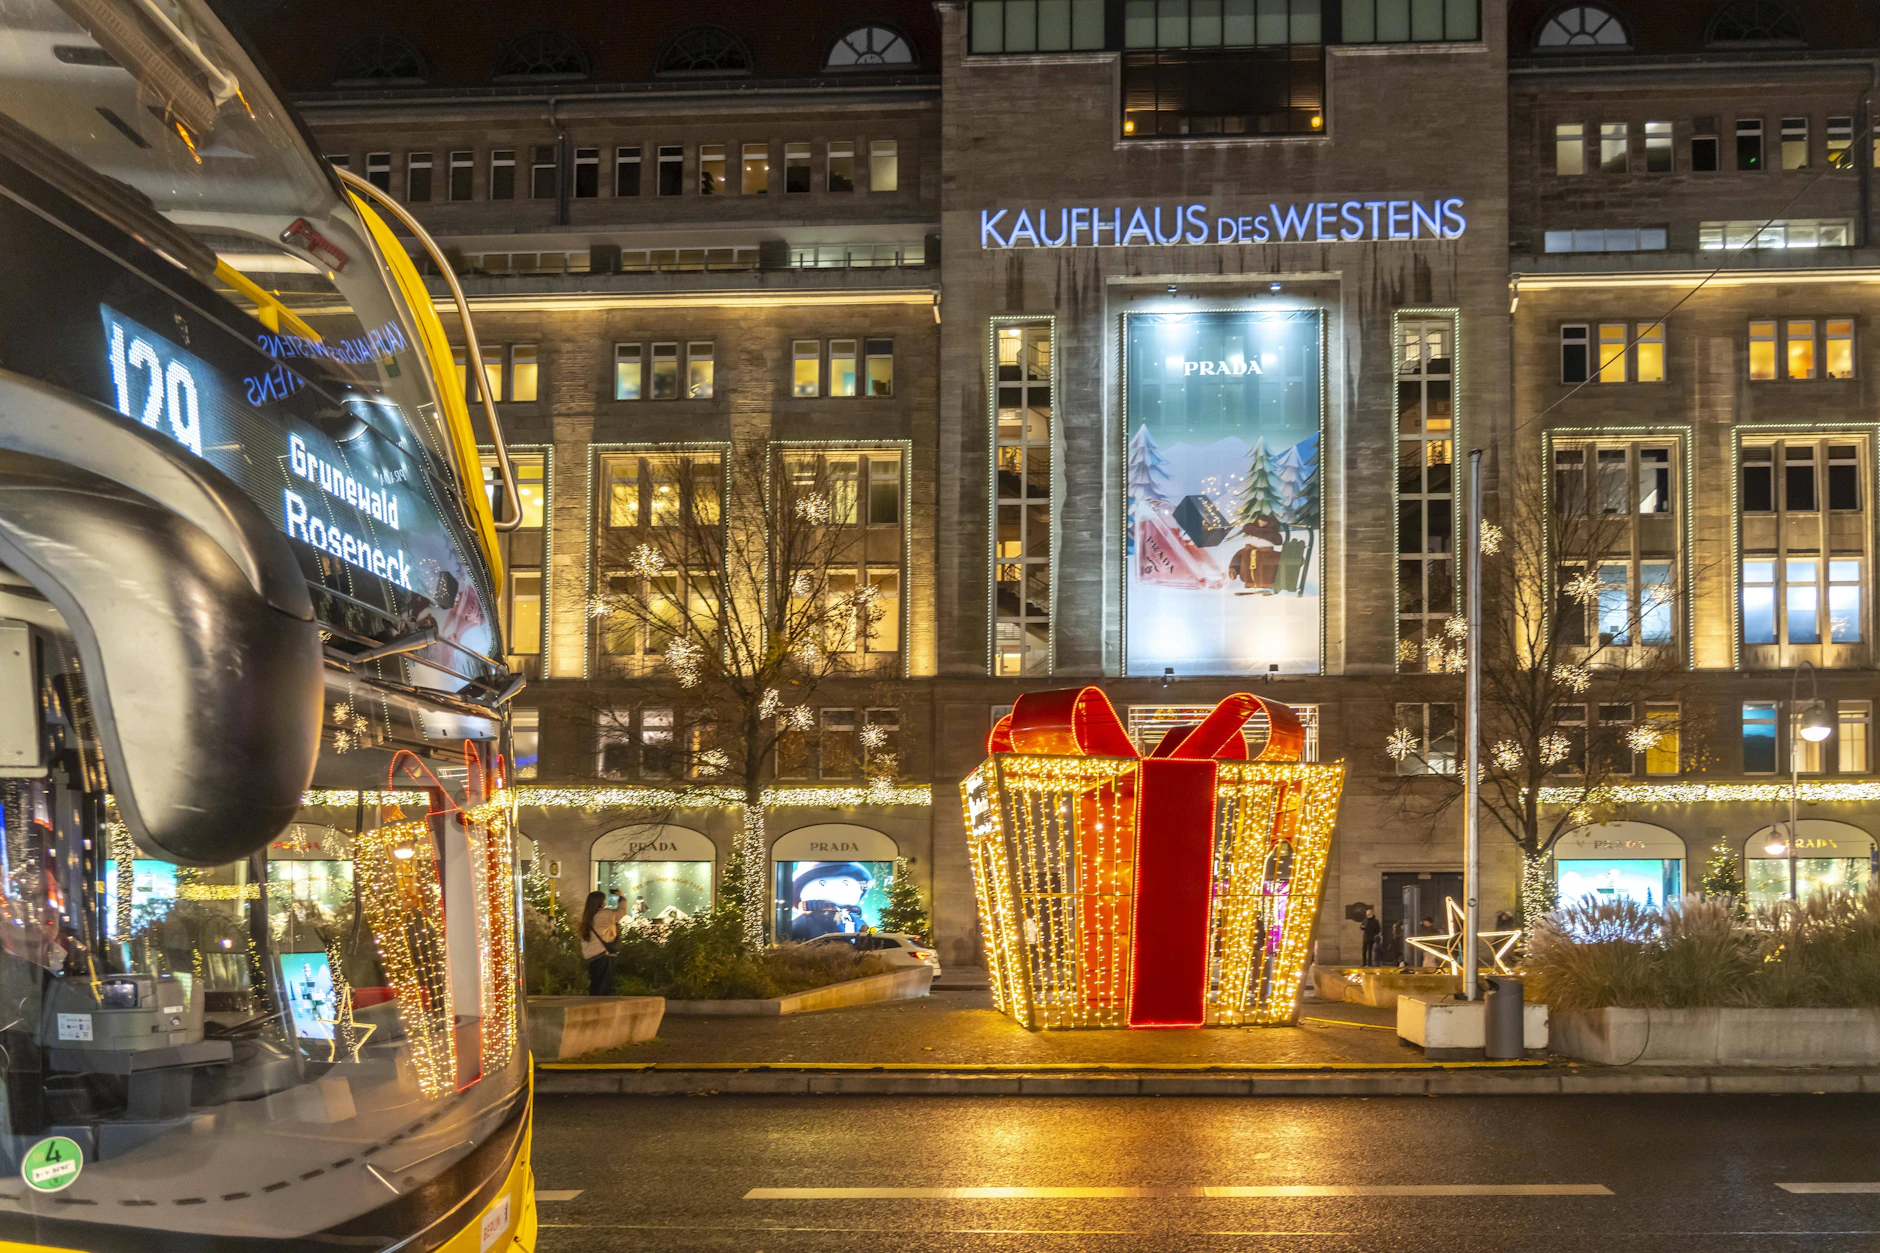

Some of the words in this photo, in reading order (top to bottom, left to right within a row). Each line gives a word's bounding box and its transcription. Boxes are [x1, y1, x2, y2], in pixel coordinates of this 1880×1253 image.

[981, 204, 1209, 249] KAUFHAUS
[1217, 215, 1270, 244] DES
[1269, 197, 1467, 243] WESTENS
[1184, 360, 1263, 377] PRADA
[108, 322, 202, 458] 129
[289, 432, 399, 530] Grunewald
[284, 488, 412, 590] Roseneck
[1146, 536, 1174, 574] PRADA
[629, 843, 677, 851] PRADA
[810, 843, 859, 851] PRADA
[46, 1141, 62, 1162] 4
